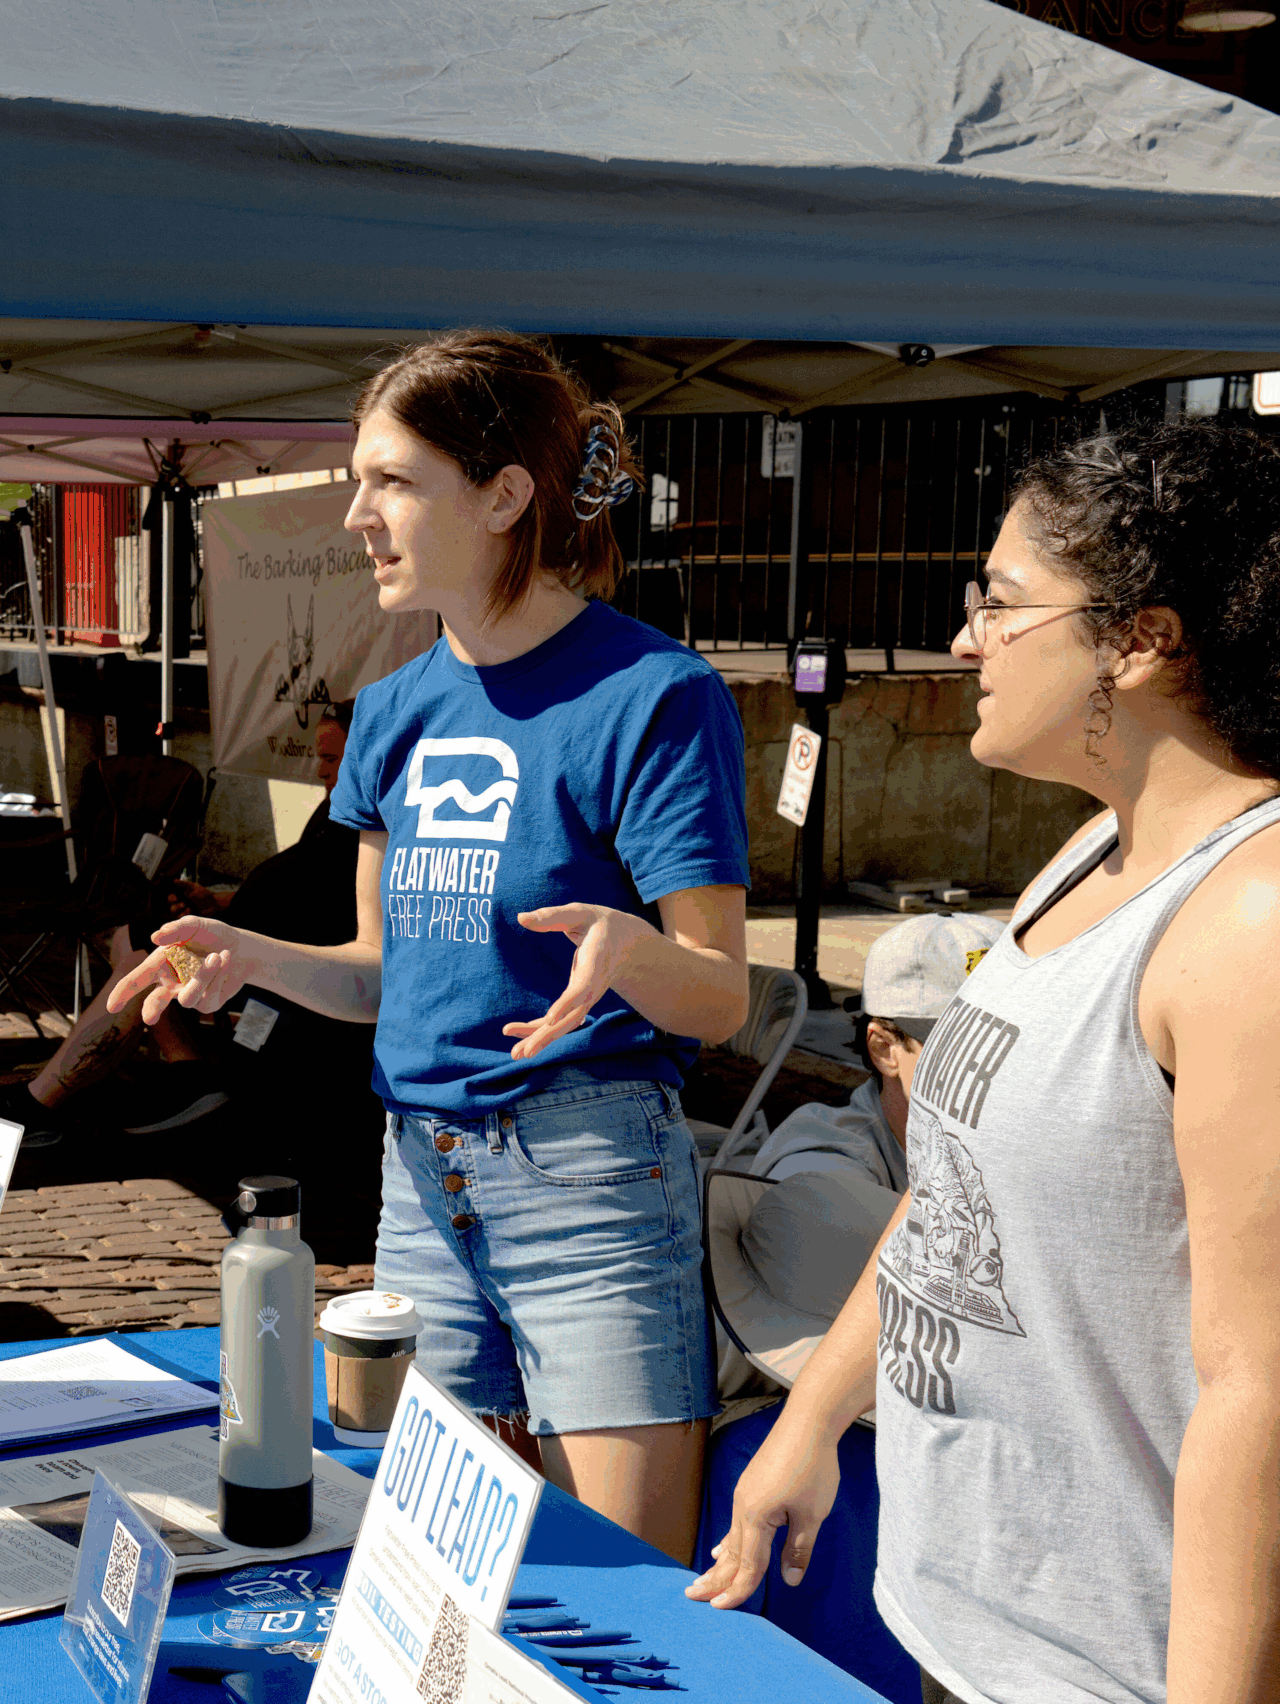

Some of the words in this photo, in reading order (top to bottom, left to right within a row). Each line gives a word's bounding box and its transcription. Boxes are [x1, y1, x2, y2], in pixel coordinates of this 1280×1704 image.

[237, 552, 262, 580] The
[263, 548, 324, 587] Barking
[389, 847, 500, 895] FLATWATER
[388, 895, 424, 938] FREE
[429, 895, 492, 944] PRESS
[383, 1395, 446, 1523] GOT
[425, 1438, 518, 1602] LEAD?
[353, 1569, 379, 1605] OIL
[374, 1598, 424, 1662] TESTING
[331, 1635, 357, 1673] GOT
[352, 1661, 363, 1685] A
